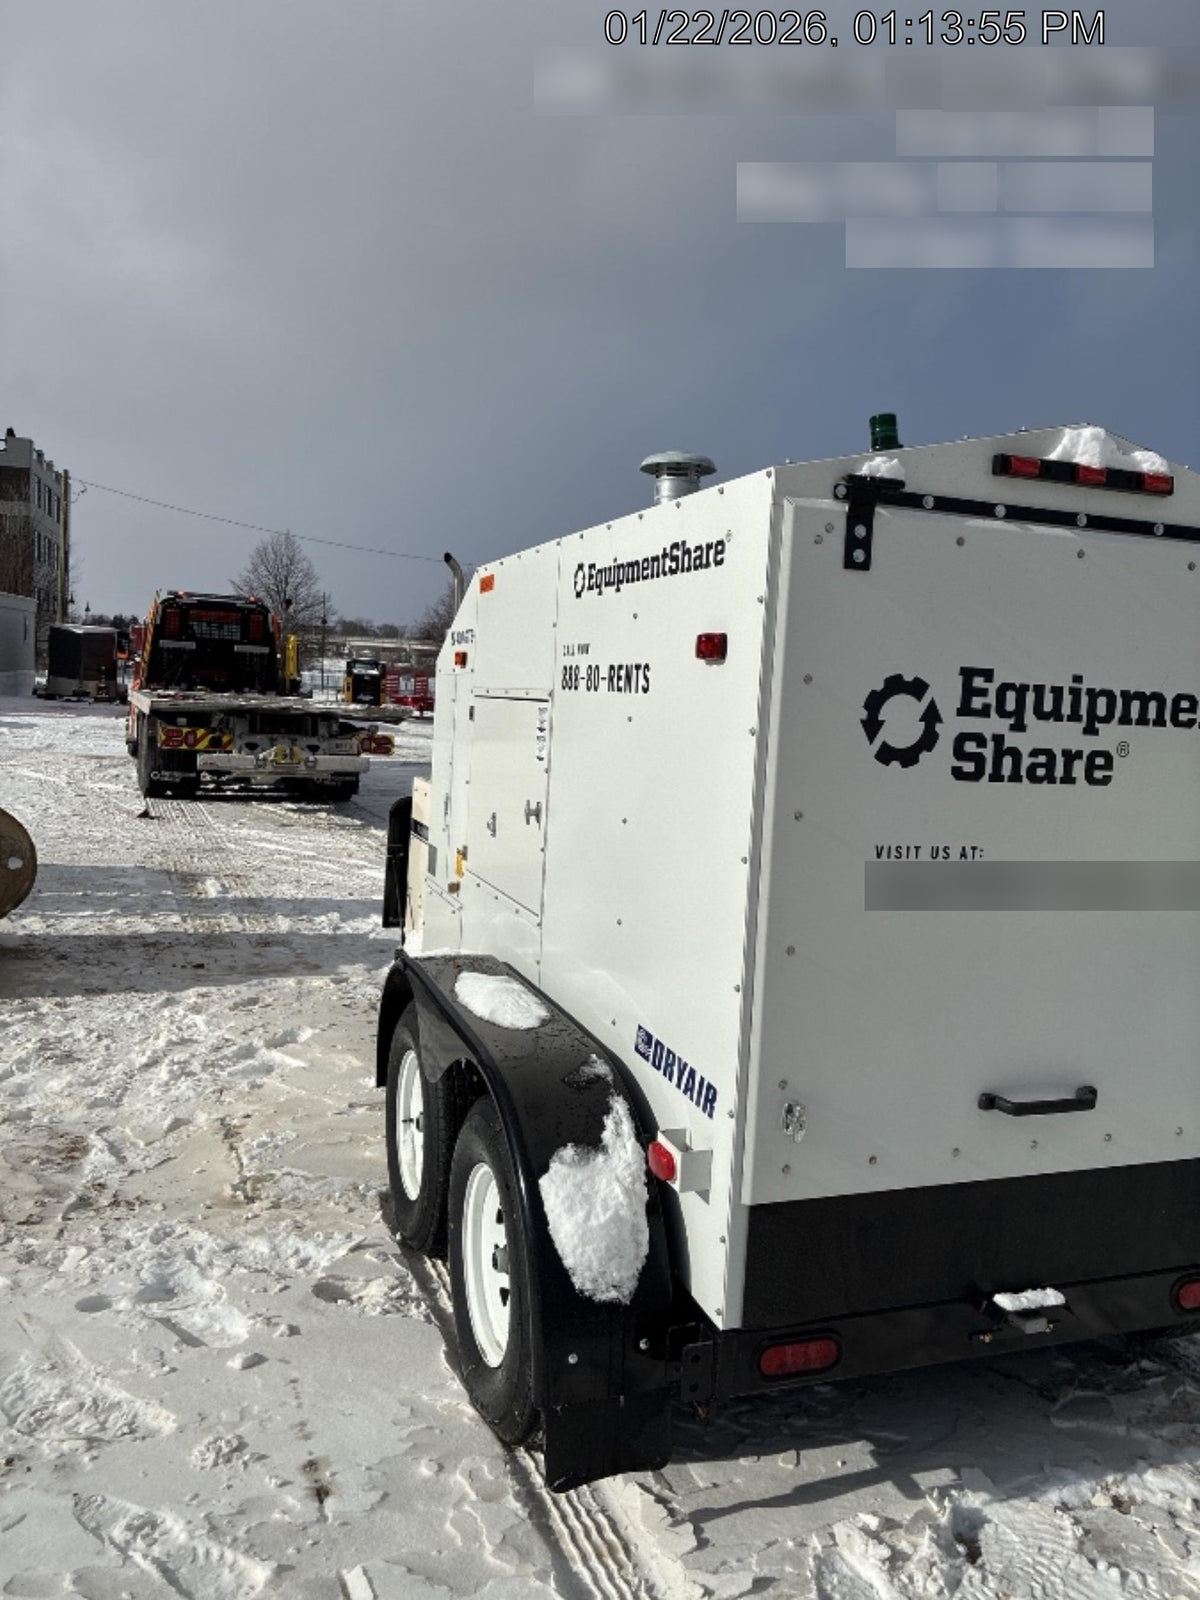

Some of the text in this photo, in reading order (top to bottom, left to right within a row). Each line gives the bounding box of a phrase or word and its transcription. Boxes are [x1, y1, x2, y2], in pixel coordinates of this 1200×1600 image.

[587, 538, 726, 596] EquipmentShare
[561, 662, 650, 694] 888-80-RENTS
[956, 666, 1200, 736] Equipme
[951, 732, 1114, 786] Share
[875, 845, 984, 860] VISIT US AT:
[651, 1038, 717, 1120] DRYAIR
